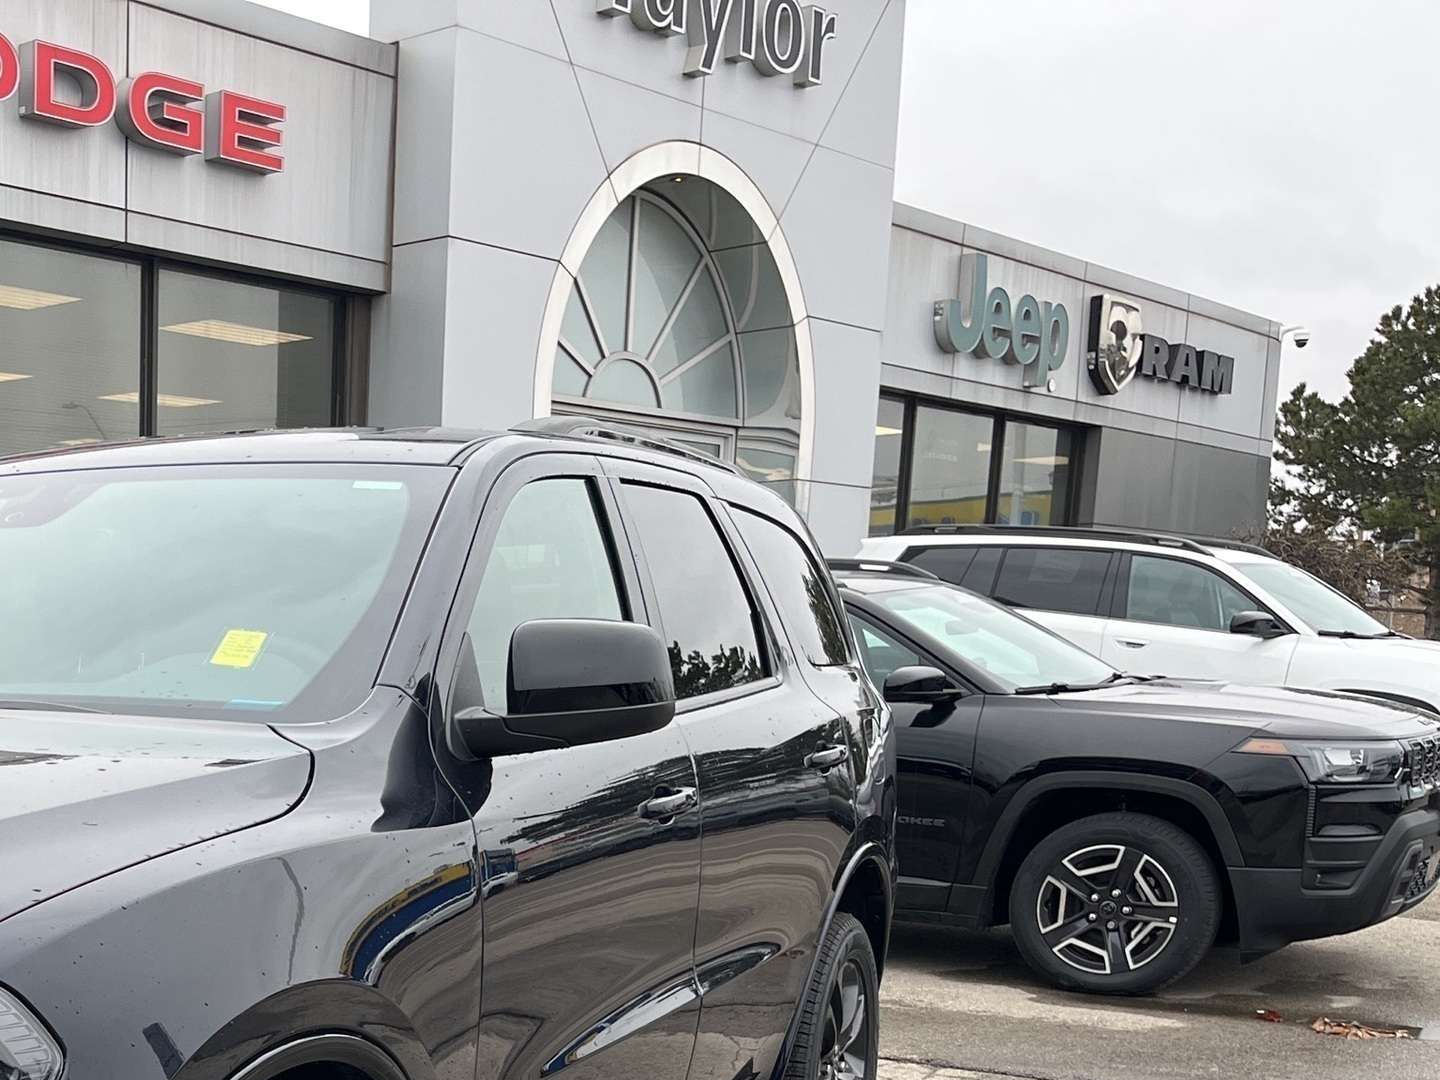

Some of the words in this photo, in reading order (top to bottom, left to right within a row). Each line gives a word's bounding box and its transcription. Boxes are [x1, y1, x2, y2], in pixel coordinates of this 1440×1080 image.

[598, 0, 839, 88] ylor
[936, 252, 1070, 388] Jeep
[1136, 333, 1236, 395] RAM
